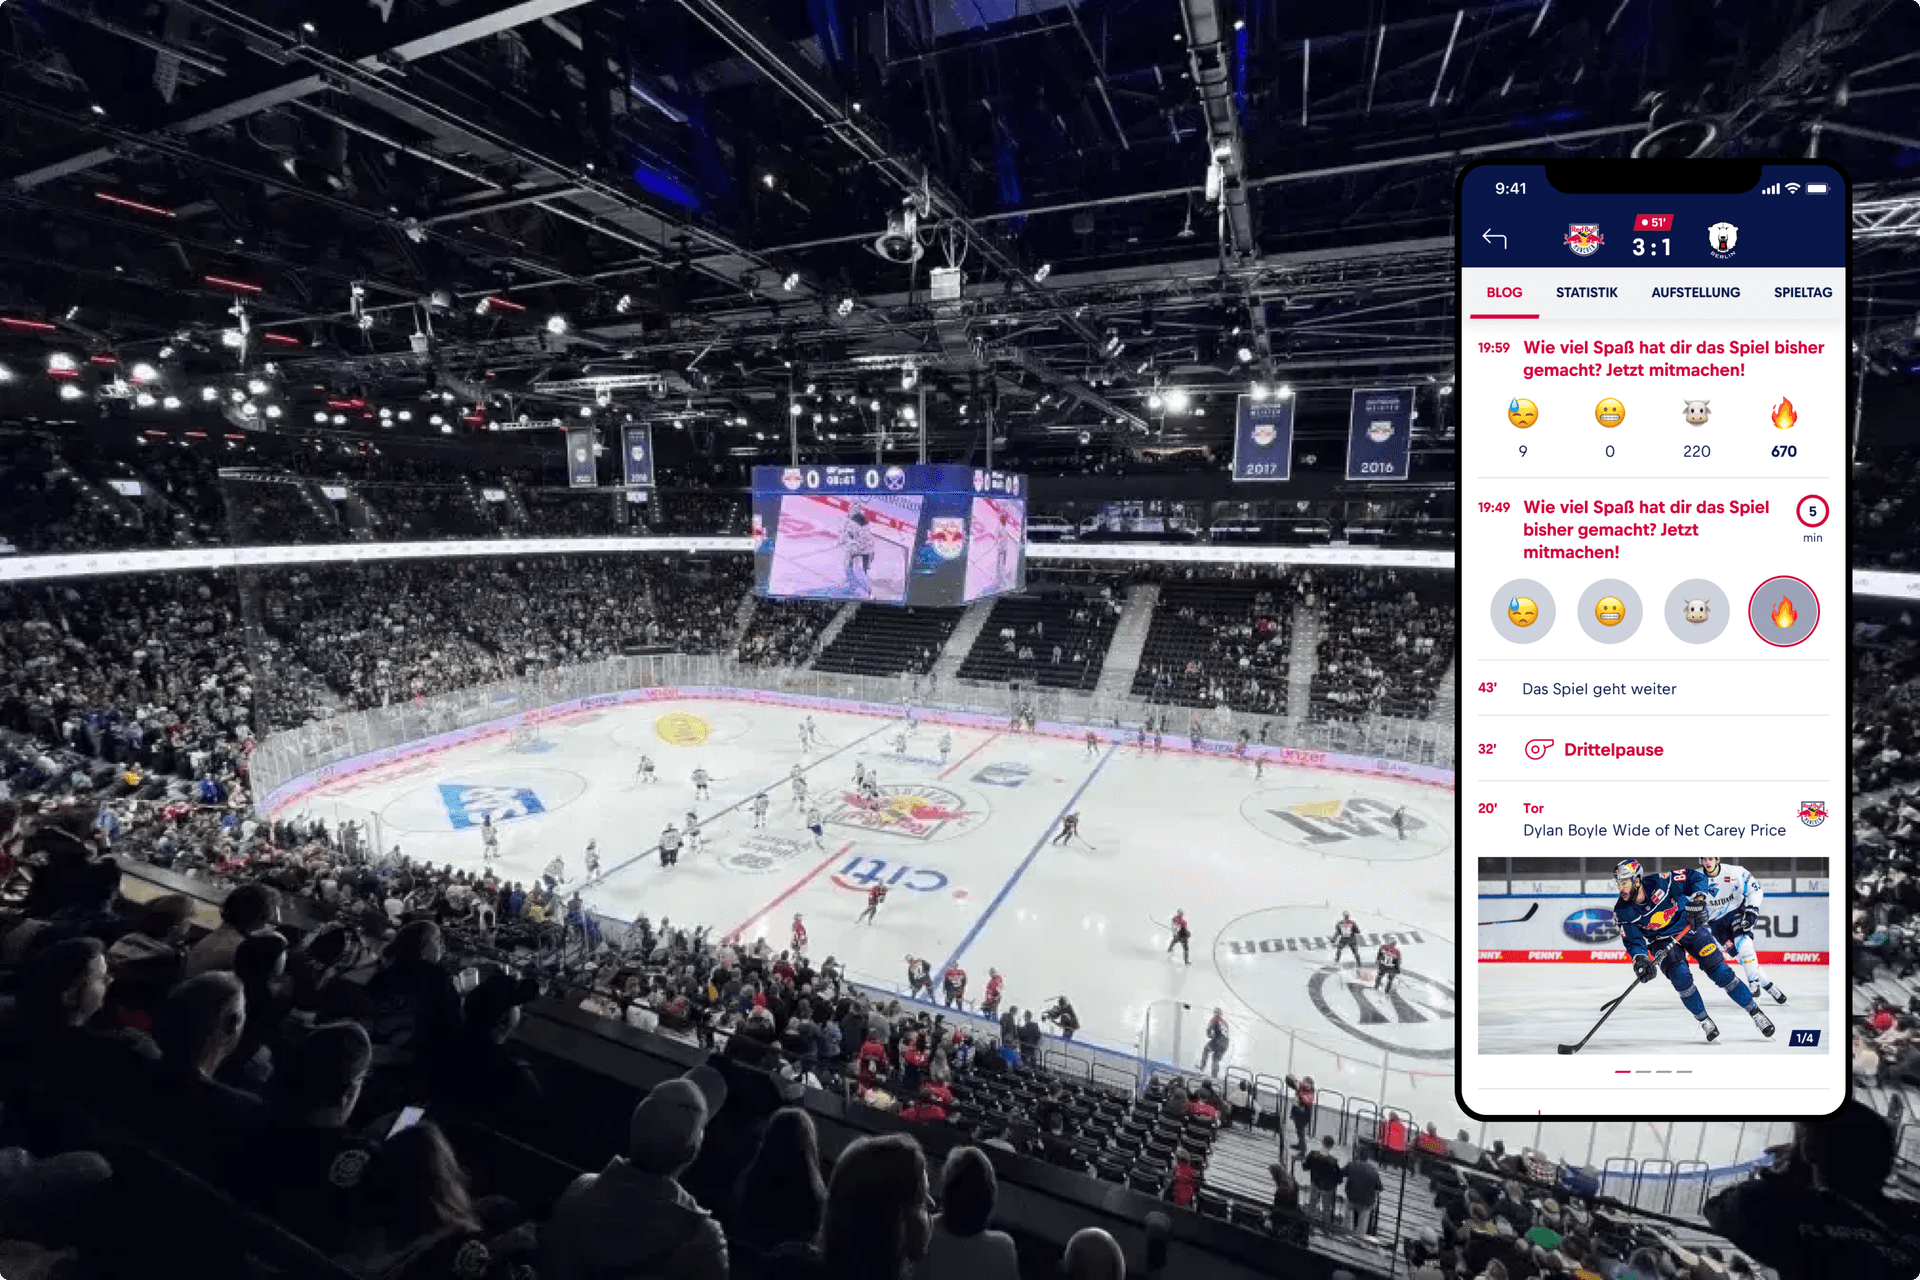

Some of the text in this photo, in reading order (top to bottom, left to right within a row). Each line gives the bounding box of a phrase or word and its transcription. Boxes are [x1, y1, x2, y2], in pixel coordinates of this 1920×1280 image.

[1495, 182, 1526, 195] 9:41
[1651, 218, 1666, 227] 51'
[1633, 238, 1645, 256] 3
[1662, 238, 1670, 256] 1
[1710, 251, 1736, 260] BERLIN
[1487, 287, 1523, 298] BLOG
[1556, 287, 1618, 298] STATISTIK
[1651, 287, 1740, 298] AUFSTELLUNG
[1774, 287, 1833, 298] SPIELTAG
[1478, 342, 1510, 353] 19:59
[1523, 339, 1825, 358] Wie viel Spaß hat dir das Spiel bisher
[1523, 362, 1745, 380] gemacht? Jetzt mitmachen!
[1519, 445, 1527, 457] 9
[1606, 445, 1615, 457] 0
[1684, 445, 1711, 457] 220
[1771, 445, 1797, 457] 670
[1246, 463, 1277, 475] 2017
[1361, 462, 1394, 474] 2016
[807, 469, 819, 488] 0
[865, 469, 879, 488] 0
[1478, 502, 1510, 513] 19:49
[1524, 499, 1769, 518] Wie viel Spaß hat dir das Spiel
[1809, 506, 1817, 517] 5
[1524, 522, 1699, 540] bisher gemacht? Jetzt
[1803, 533, 1823, 542] min
[1524, 544, 1619, 559] mitmachen!
[1478, 682, 1497, 693] 43'
[1523, 682, 1677, 699] Das Spiel geht weiter
[1478, 743, 1496, 754] 32'
[1565, 742, 1664, 759] Drittelpause
[1478, 803, 1497, 814] 20'
[1523, 803, 1544, 814] Tor
[1524, 824, 1786, 840] Dylan Boyle Wide of Net Carey Price
[1796, 1033, 1813, 1044] 1/4
